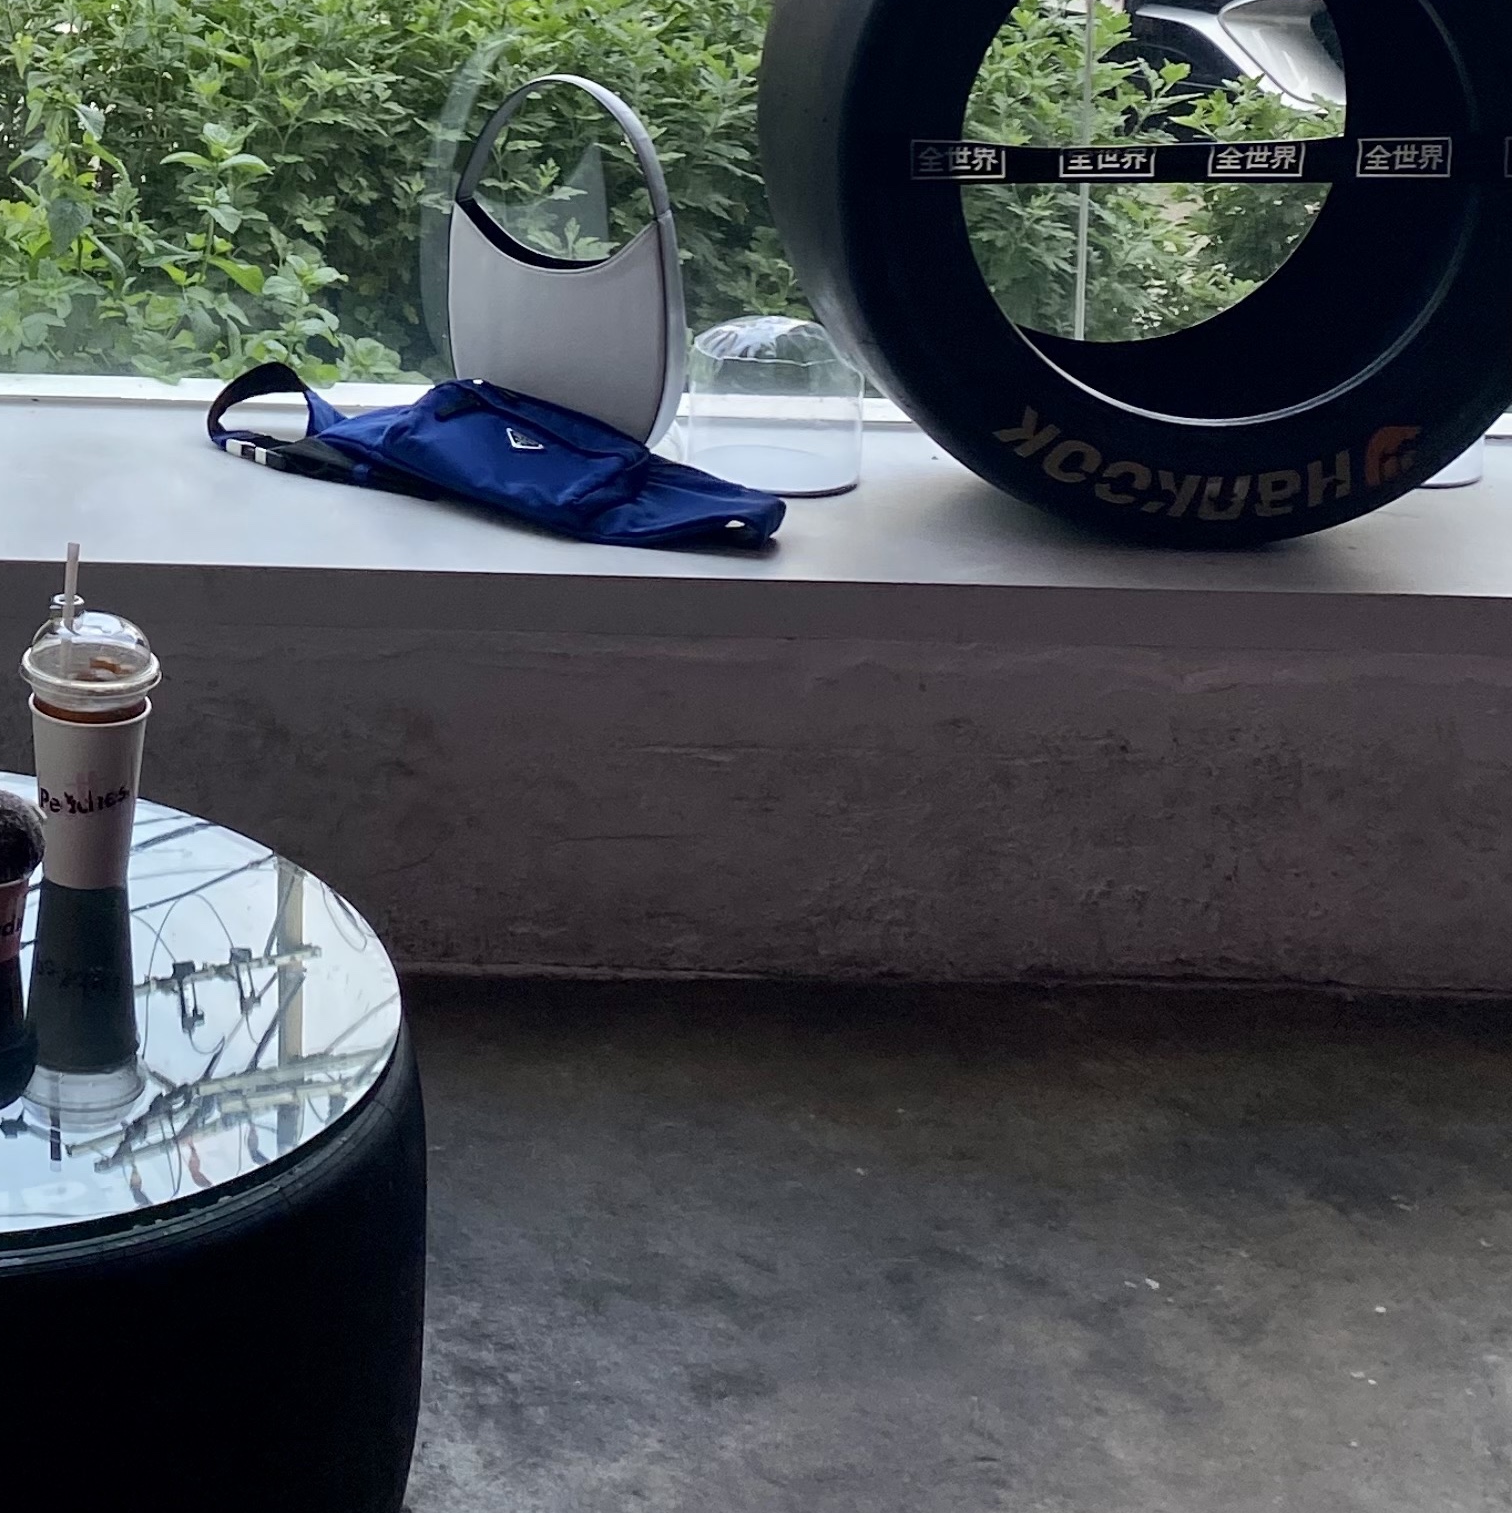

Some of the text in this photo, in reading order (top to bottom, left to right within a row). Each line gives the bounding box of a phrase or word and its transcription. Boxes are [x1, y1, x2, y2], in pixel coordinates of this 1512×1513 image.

[918, 146, 999, 172] 全世界
[1216, 144, 1298, 170] 全世界
[1364, 144, 1445, 171] 全世界
